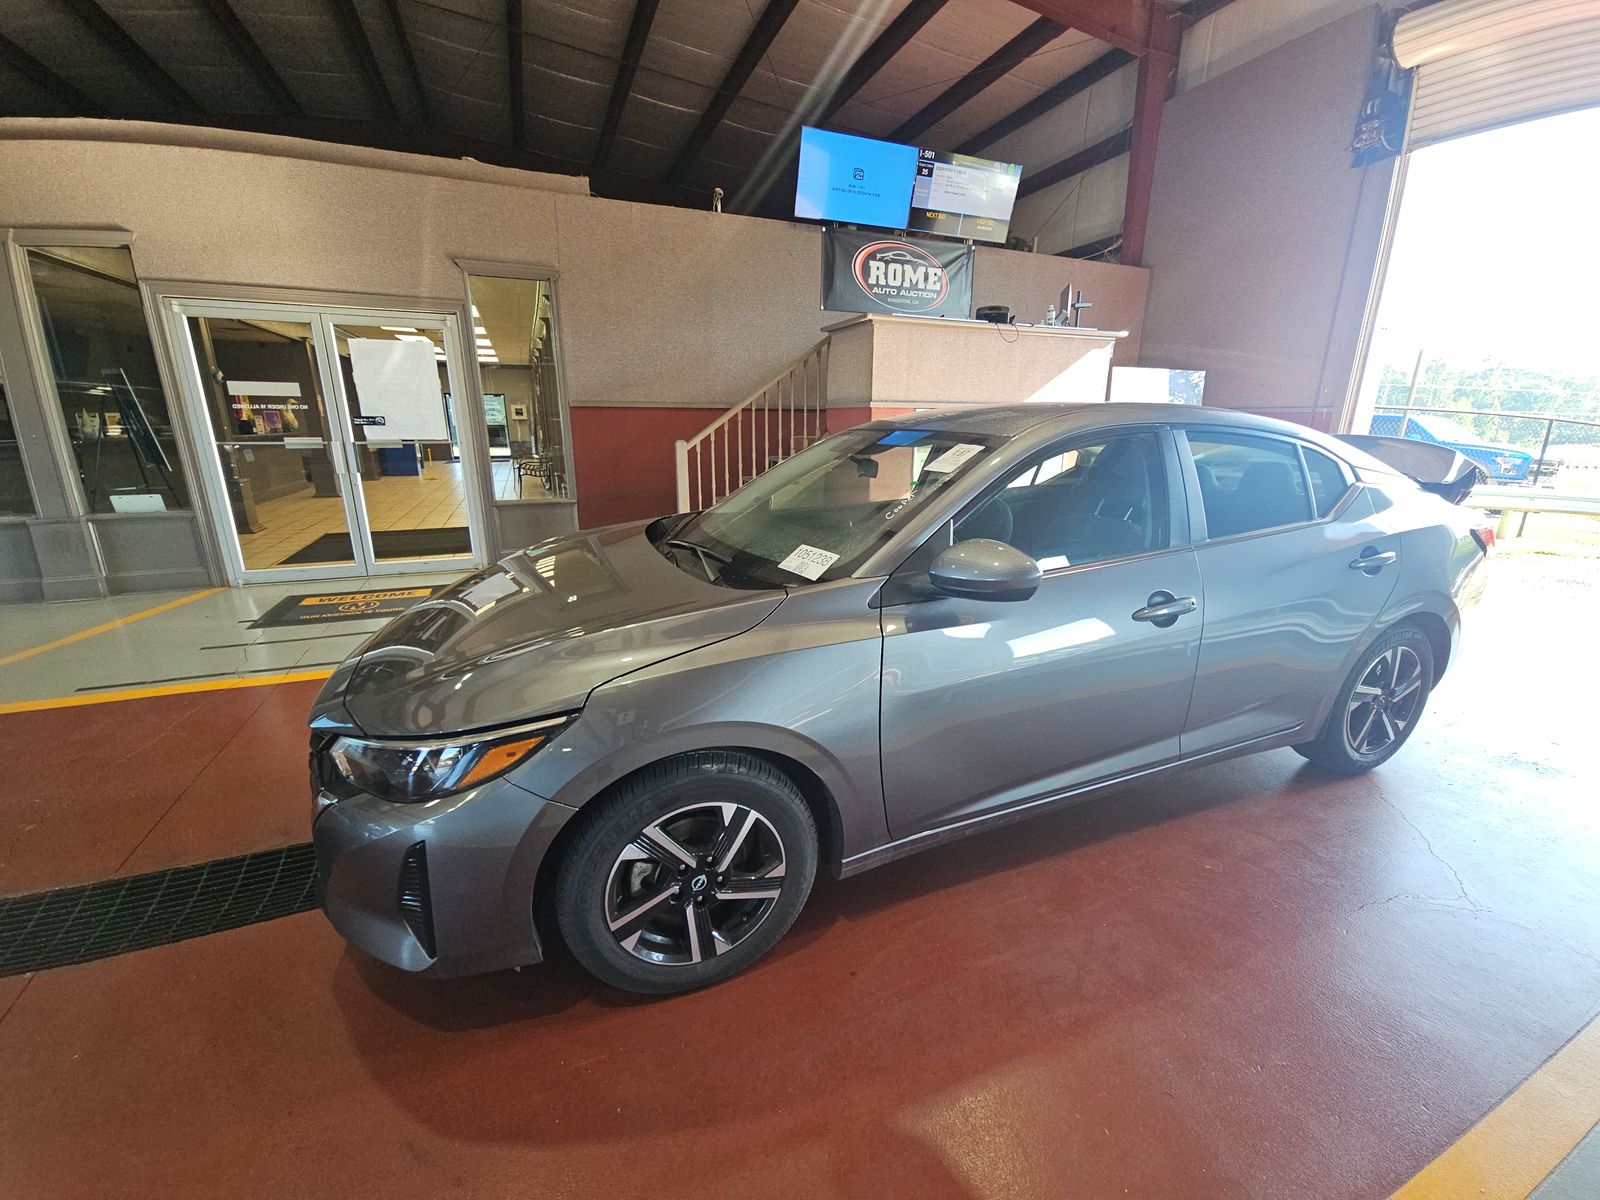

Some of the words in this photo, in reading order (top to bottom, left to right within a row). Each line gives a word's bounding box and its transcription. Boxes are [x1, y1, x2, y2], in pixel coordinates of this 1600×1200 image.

[868, 260, 942, 291] ROME
[872, 287, 897, 295] AUTO
[899, 289, 937, 299] AUCTION
[793, 548, 833, 567] 1051238
[318, 590, 417, 603] WELCOME
